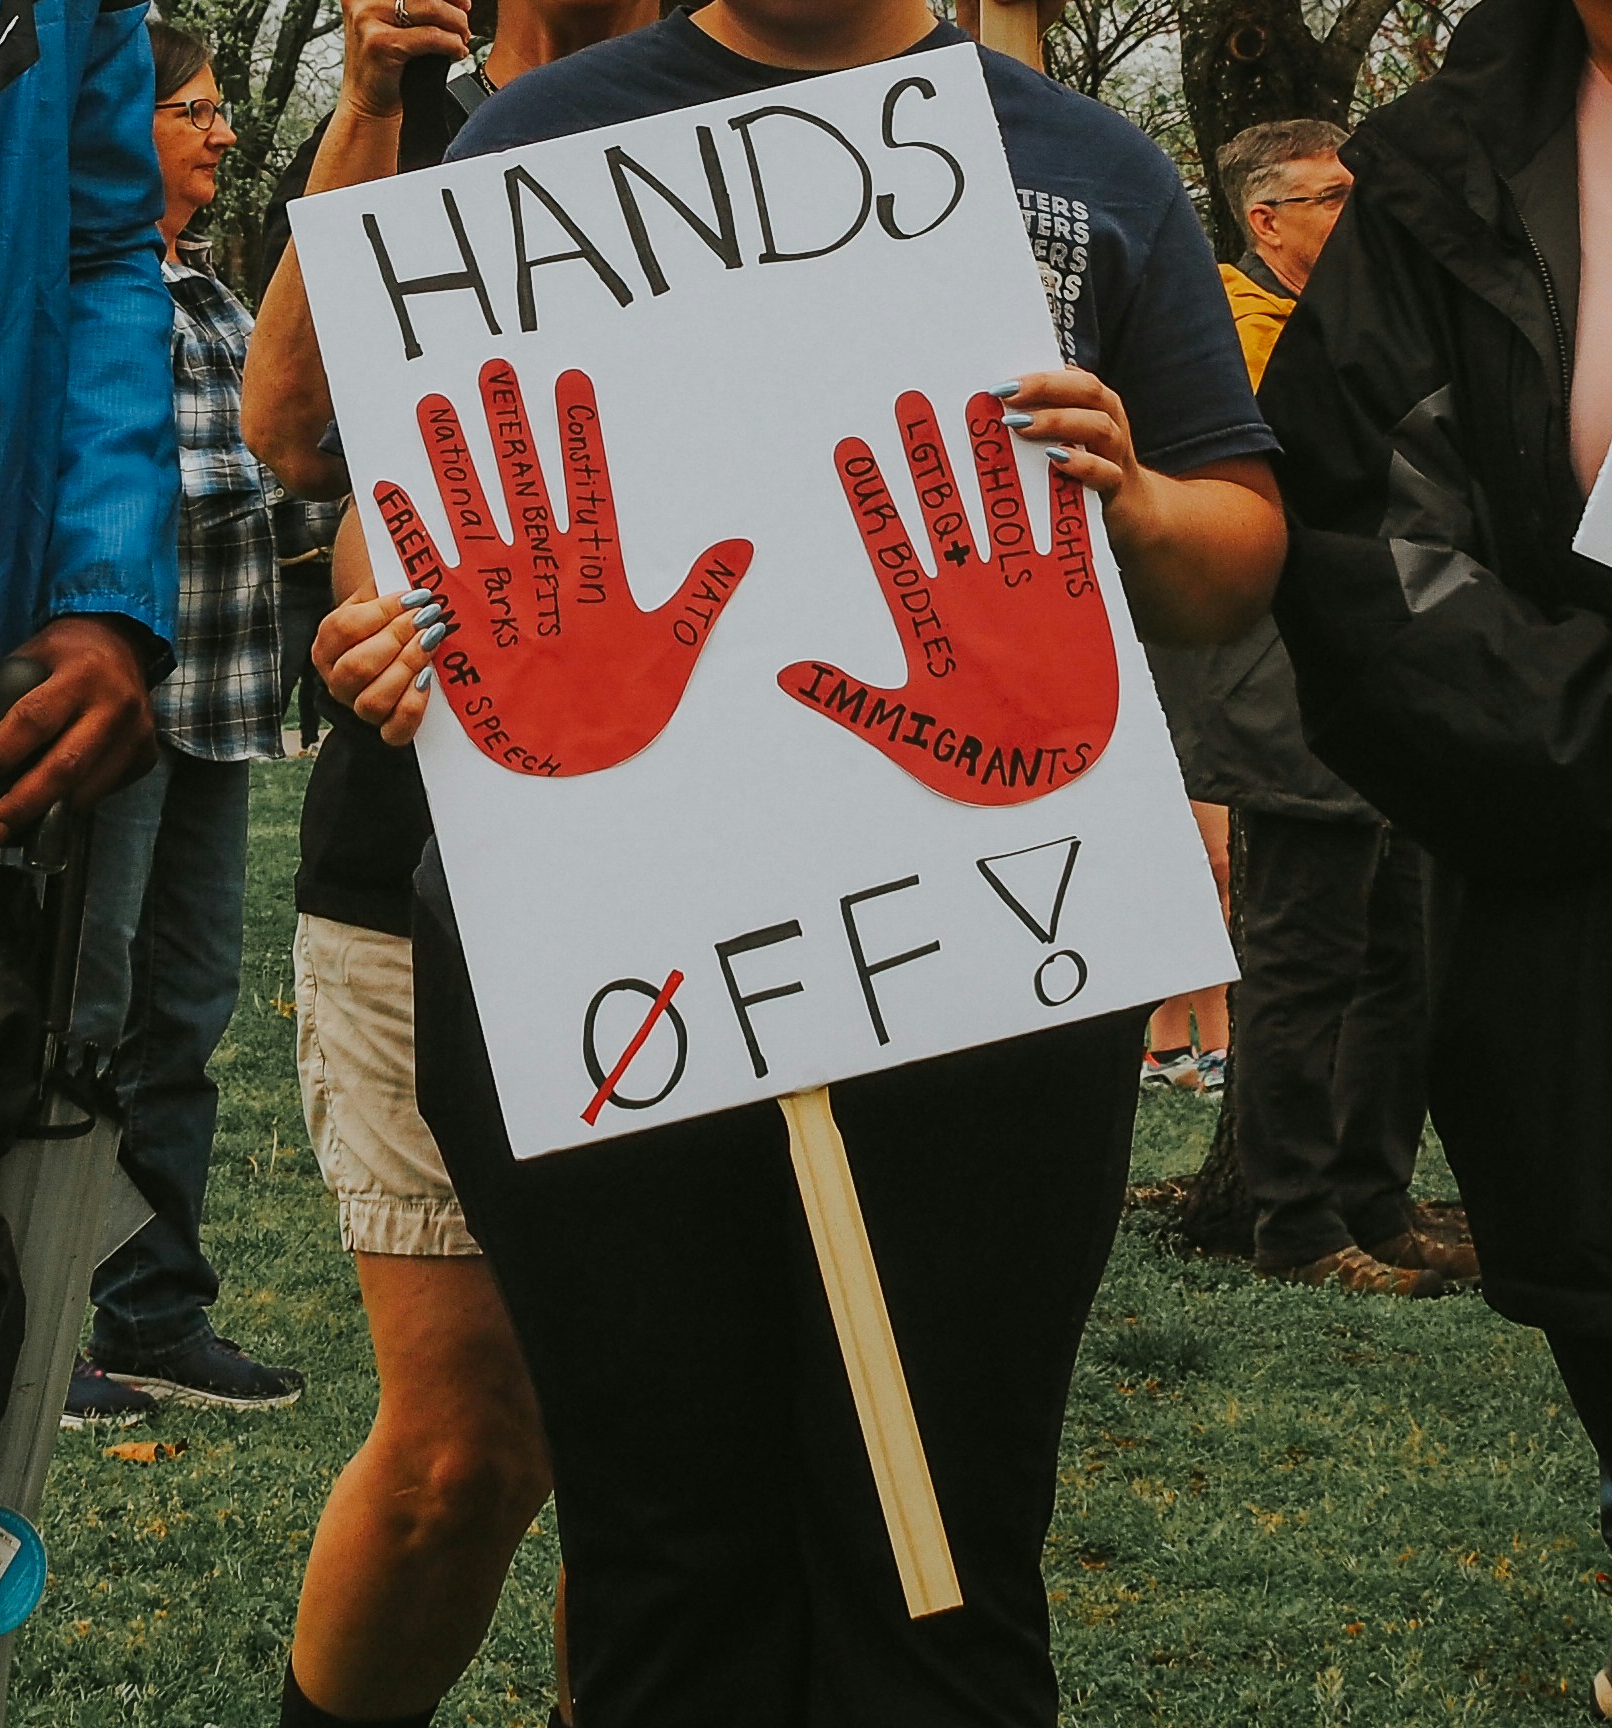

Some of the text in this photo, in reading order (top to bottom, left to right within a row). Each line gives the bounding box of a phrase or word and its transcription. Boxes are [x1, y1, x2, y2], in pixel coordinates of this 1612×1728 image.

[360, 75, 966, 362] HANDS
[429, 407, 520, 649] National Parks
[487, 369, 562, 637] VETERAN BENEFITS
[566, 404, 615, 606] Constitution
[843, 455, 957, 679] OUR BODIES
[905, 418, 972, 569] LGTBQ+
[969, 417, 1033, 589] SCHOOLS
[672, 558, 736, 647] NATO
[442, 651, 482, 687] OF
[464, 694, 563, 777] SPEECH
[797, 662, 1092, 788] IMMIGRANTS
